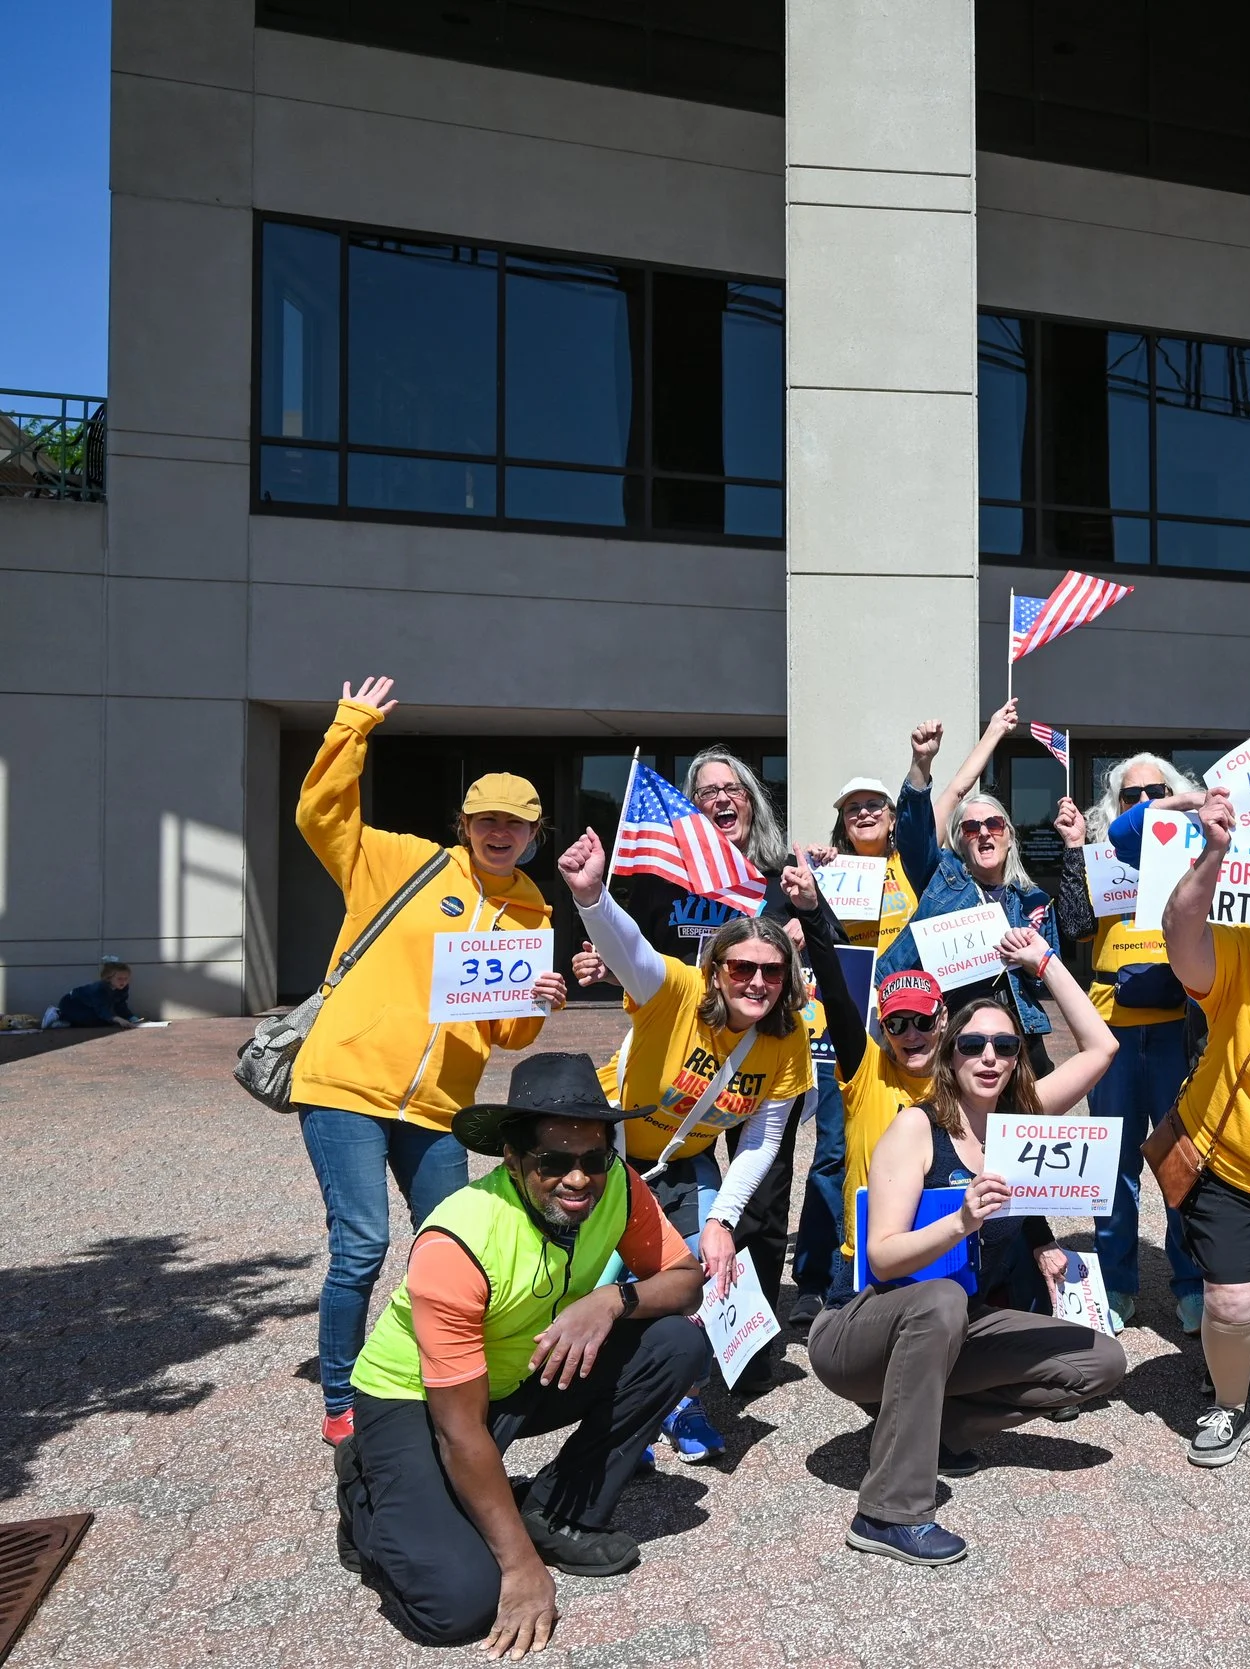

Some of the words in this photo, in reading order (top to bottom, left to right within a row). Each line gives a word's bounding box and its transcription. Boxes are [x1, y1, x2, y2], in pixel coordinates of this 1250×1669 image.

[1215, 770, 1222, 780] I
[829, 860, 876, 870] LLECTED
[1095, 851, 1099, 861] I
[923, 927, 928, 937] I
[932, 910, 996, 934] COLLECTED
[448, 941, 452, 952] I
[461, 938, 542, 952] COLLECTED
[942, 930, 986, 960] 1,181
[460, 958, 532, 985] 330
[937, 951, 1001, 977] SIGNATURE
[446, 988, 537, 1004] SIGNATURES
[684, 1047, 767, 1096] RESECT
[1002, 1124, 1006, 1137] I
[1016, 1125, 1108, 1140] COLLECTED
[1018, 1142, 1089, 1178] 451
[1008, 1186, 1100, 1198] IGNATURES
[1078, 1264, 1099, 1330] GNATURES
[719, 1304, 737, 1333] 70
[723, 1312, 765, 1364] SIGNATURES
